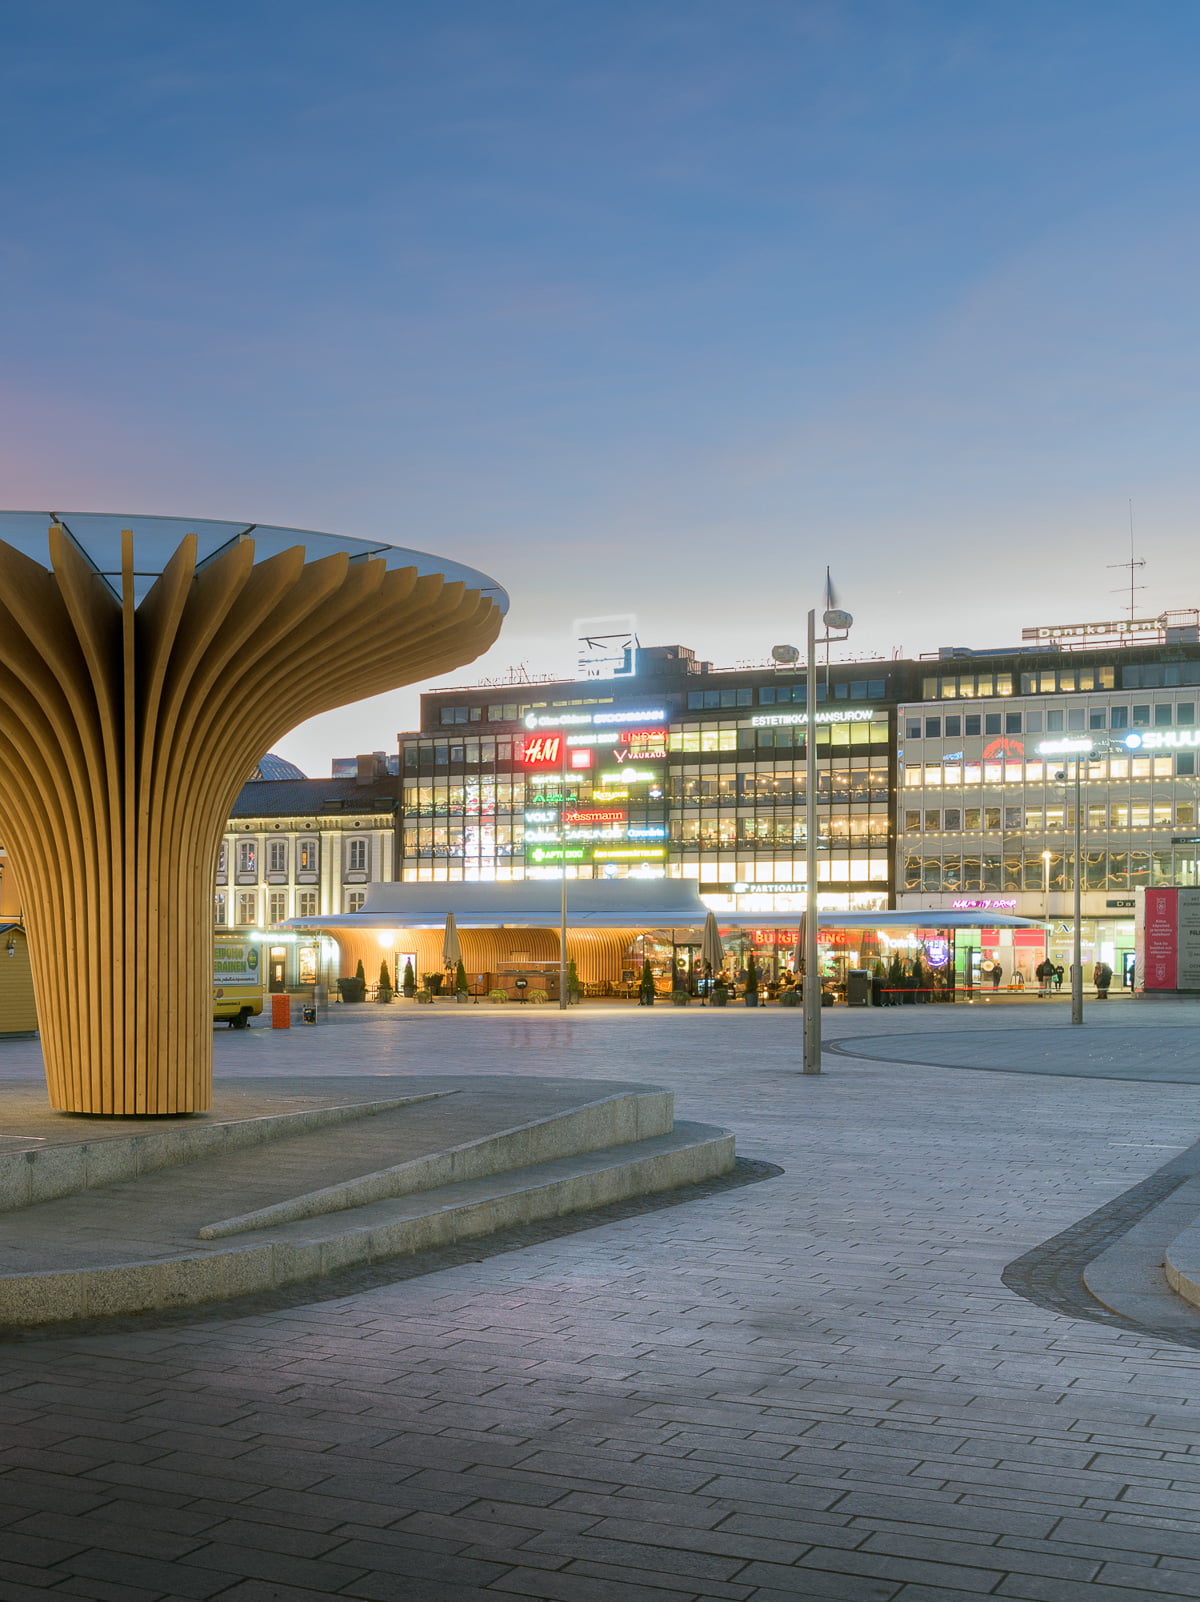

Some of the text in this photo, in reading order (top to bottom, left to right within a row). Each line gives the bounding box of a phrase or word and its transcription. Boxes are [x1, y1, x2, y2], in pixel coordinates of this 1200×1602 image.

[1038, 620, 1162, 638] Danske Bank
[525, 738, 560, 763] H&M
[627, 751, 667, 760] VAURAUS
[525, 811, 556, 823] VOLT
[750, 884, 808, 893] PARTIOAITT
[755, 932, 798, 945] BURGE
